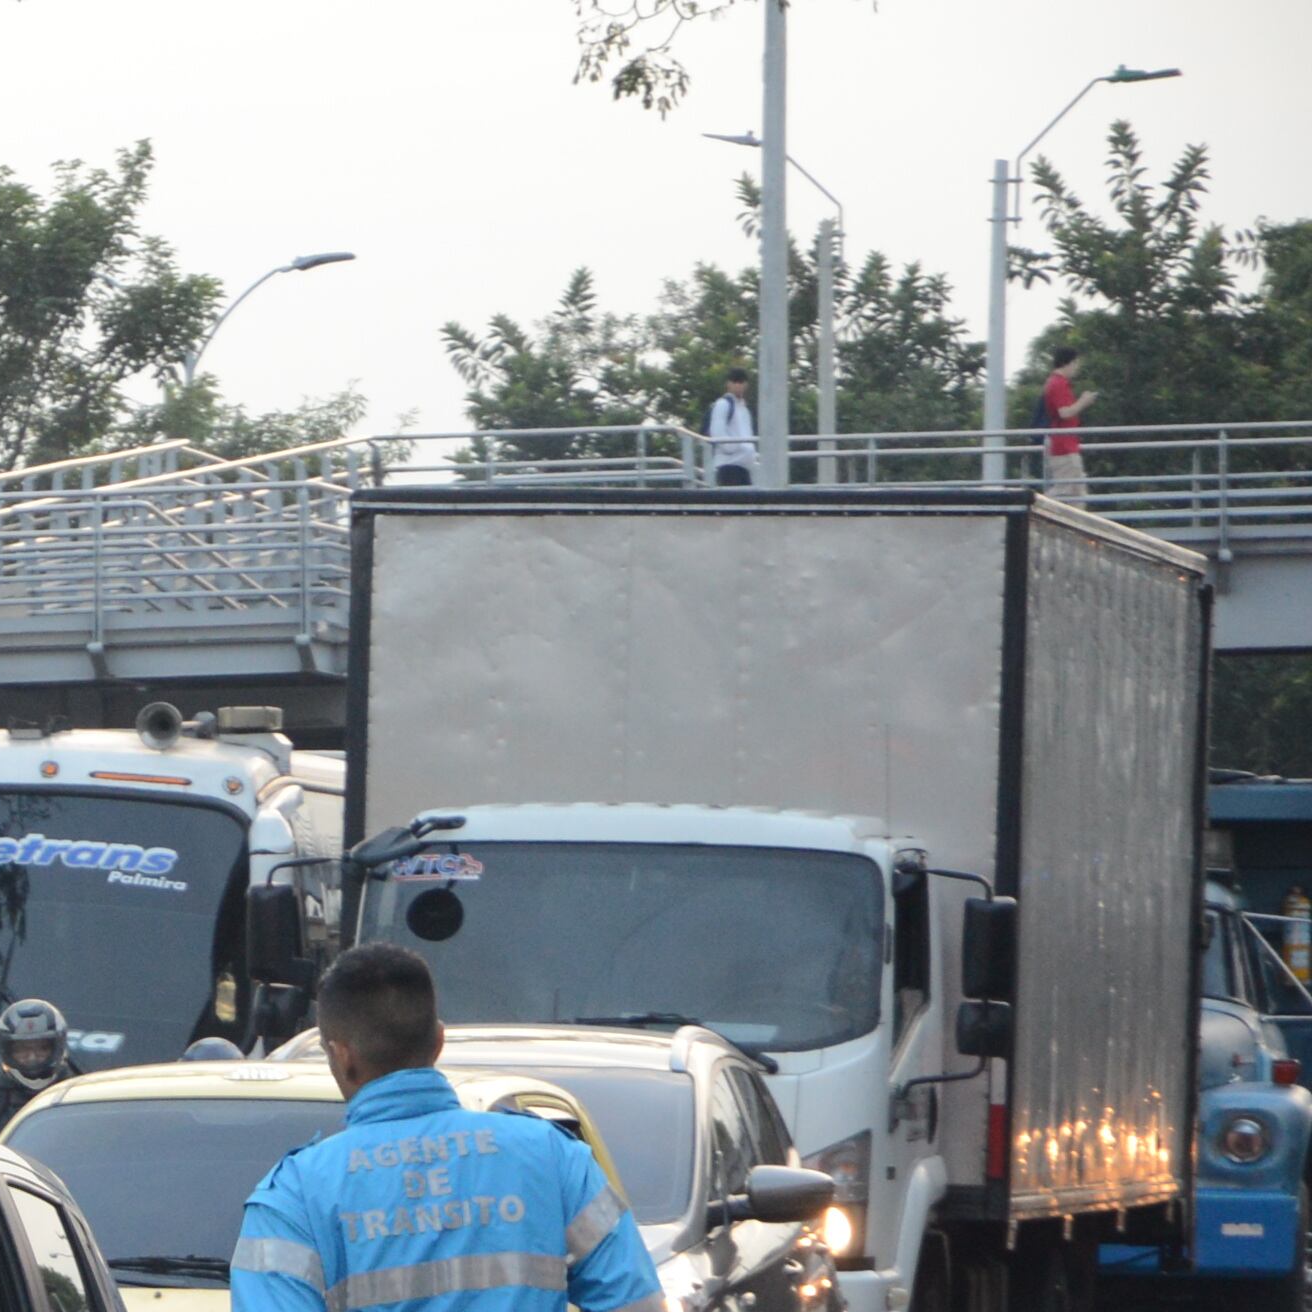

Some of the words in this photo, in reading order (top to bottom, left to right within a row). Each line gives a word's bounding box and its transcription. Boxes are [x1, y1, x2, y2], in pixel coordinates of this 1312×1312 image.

[107, 870, 187, 891] Palmira
[347, 1129, 499, 1174] AGENTE
[402, 1167, 452, 1199] DE
[339, 1194, 525, 1243] TRANSITO
